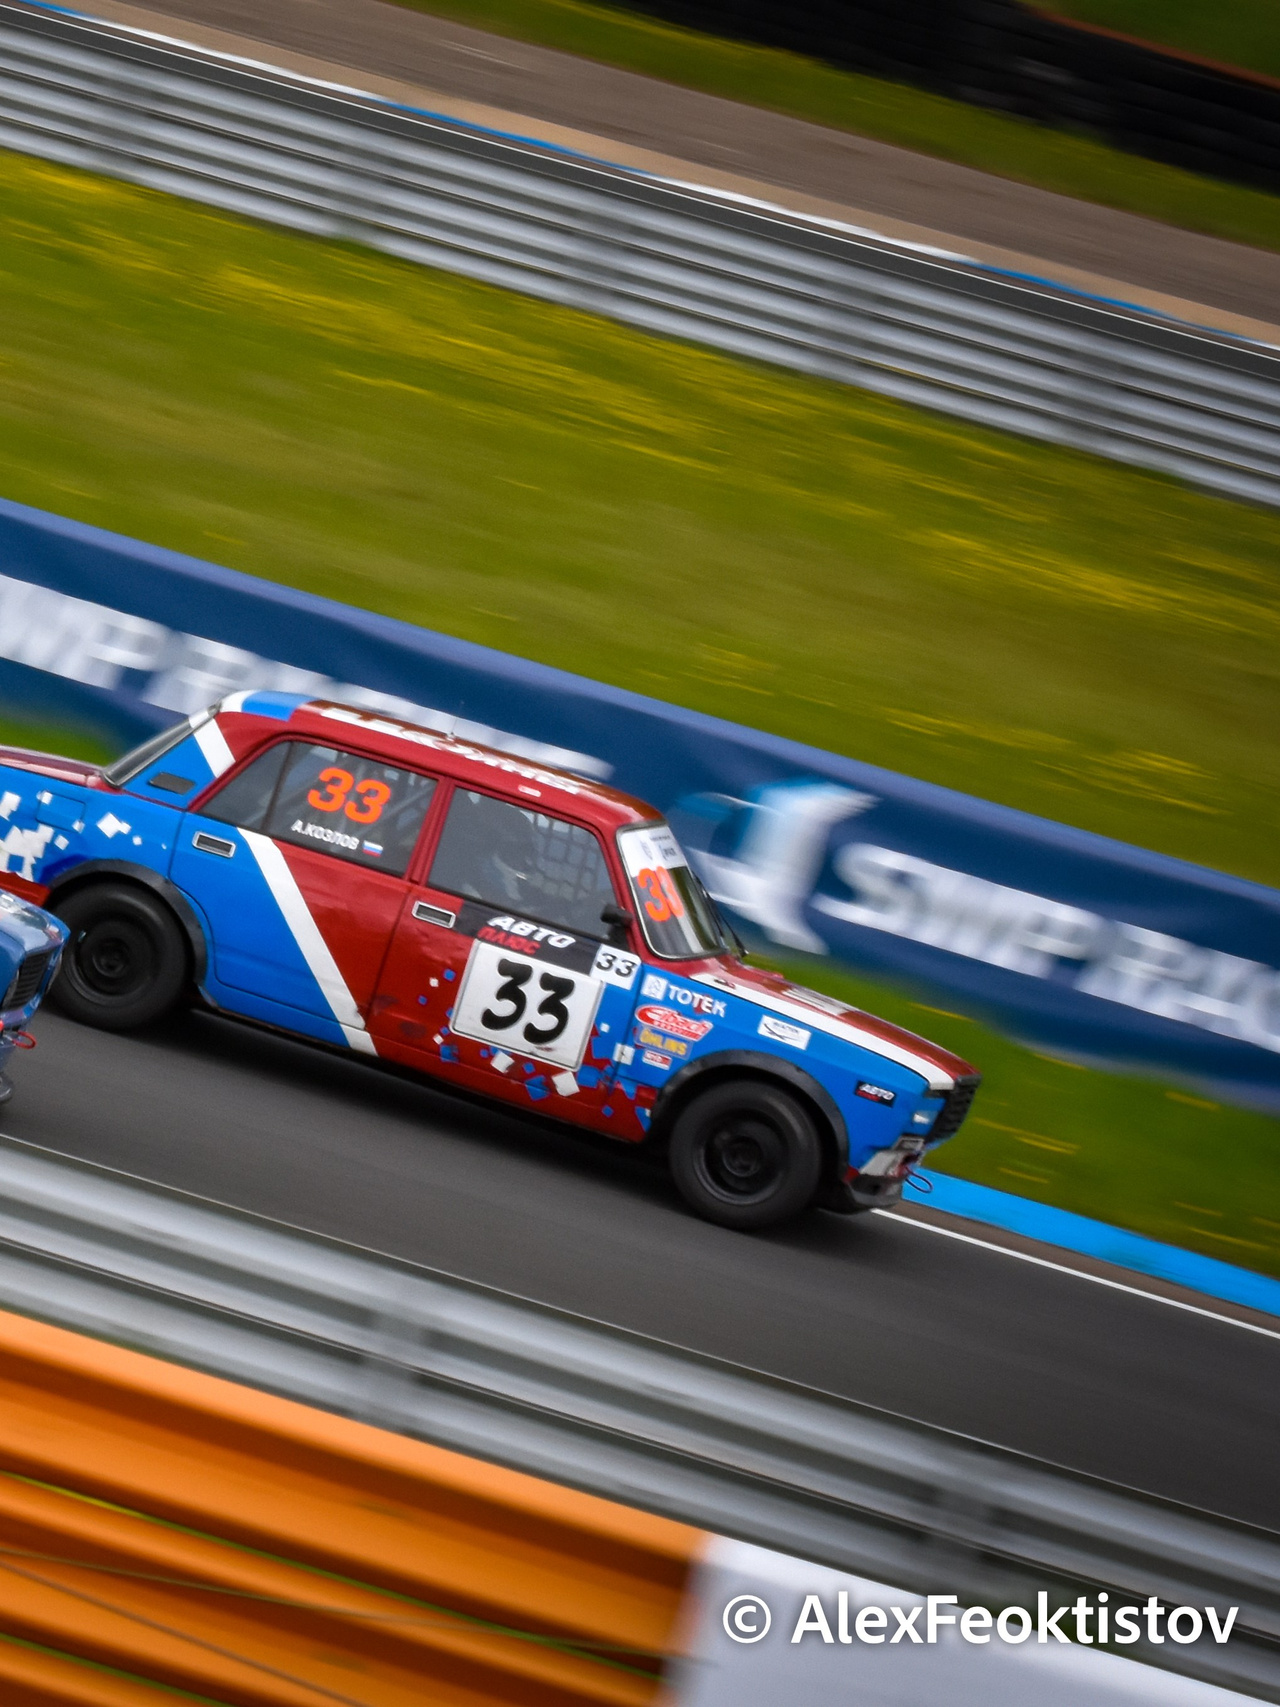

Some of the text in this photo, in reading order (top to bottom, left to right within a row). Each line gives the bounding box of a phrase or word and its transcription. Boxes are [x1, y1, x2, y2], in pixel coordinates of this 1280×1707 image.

[307, 766, 392, 824] 33
[487, 915, 576, 949] АВТО
[596, 953, 637, 978] 33
[481, 958, 575, 1045] 33
[668, 984, 728, 1018] TOTEK
